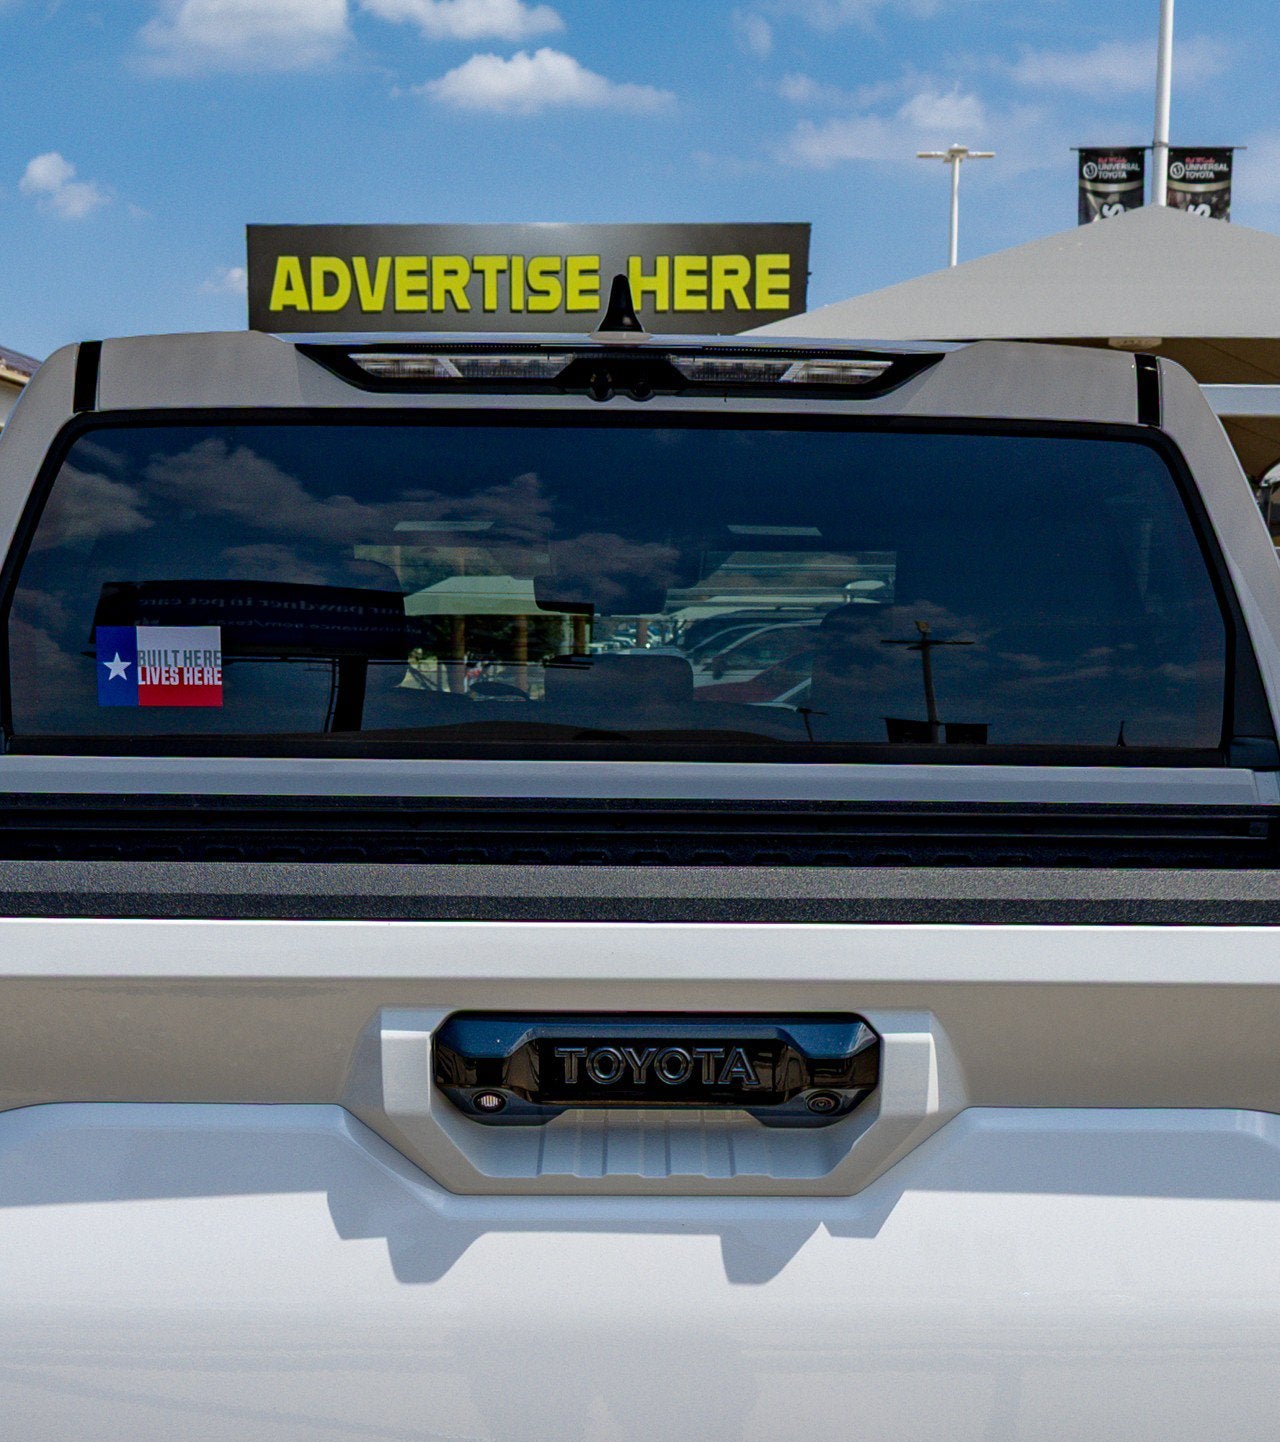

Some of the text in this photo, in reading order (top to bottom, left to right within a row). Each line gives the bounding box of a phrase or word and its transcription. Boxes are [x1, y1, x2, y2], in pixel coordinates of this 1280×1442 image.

[1098, 162, 1140, 171] UNIVERSAL
[1185, 162, 1229, 171] UNIVERSAL
[1099, 170, 1127, 179] TOYOTA
[1186, 170, 1215, 179] TOYOTA
[269, 254, 791, 313] ADVERTISE HERE
[138, 649, 221, 667] BUILT HERE
[138, 666, 222, 685] LIVES HERE
[555, 1047, 759, 1085] TOYOTA
